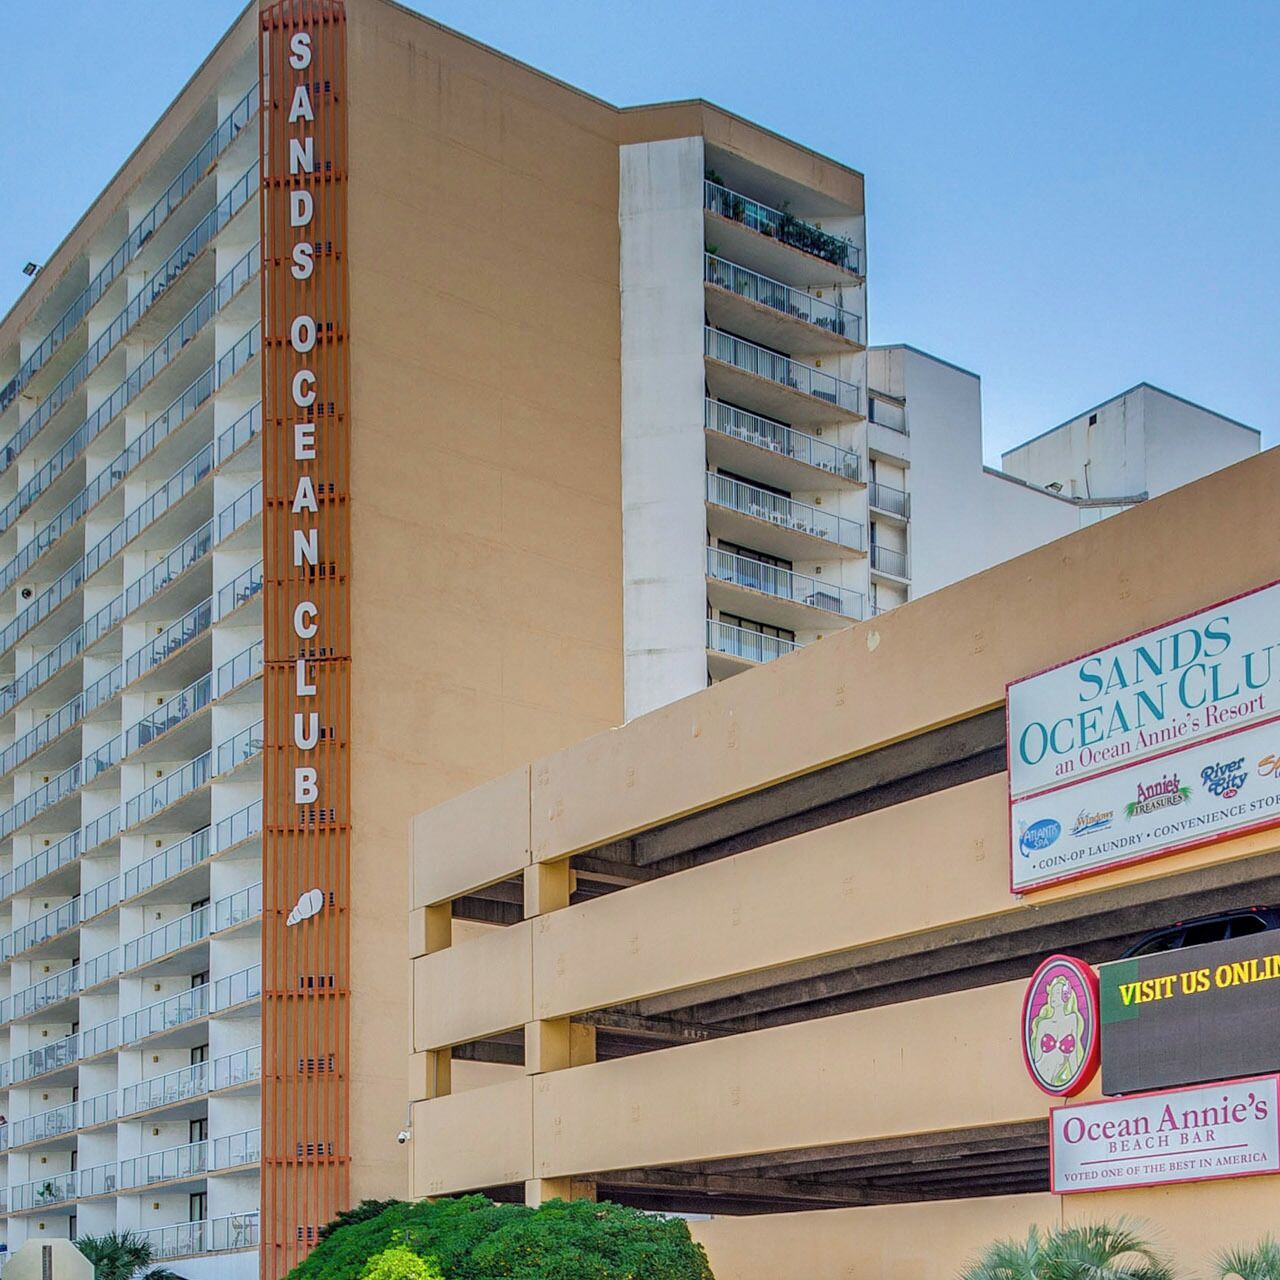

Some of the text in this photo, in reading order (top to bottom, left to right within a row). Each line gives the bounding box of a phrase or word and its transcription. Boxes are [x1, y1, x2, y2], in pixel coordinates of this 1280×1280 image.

[288, 32, 319, 805] SANDS OCEAN CLUB
[1079, 616, 1232, 702] SANDS
[1019, 682, 1168, 766] OCEAN
[1055, 693, 1265, 776] an Ocean Annie's Resort
[1136, 773, 1180, 805] Annie's
[1200, 757, 1245, 787] River
[1208, 772, 1248, 796] City
[1134, 794, 1183, 815] TREASURES
[1034, 838, 1050, 850] SPA
[1038, 848, 1086, 870] COIN-OP
[1088, 833, 1144, 857] LAUNDRY
[1153, 804, 1247, 838] CONVENIENCE
[1118, 974, 1177, 1007] VISIT
[1180, 968, 1211, 995] US
[1063, 1093, 1269, 1144] Ocean Annie's
[1108, 1129, 1217, 1153] BEACH BAR
[1064, 1152, 1269, 1182] VOTED ONE OF THE BEST IN AMERICA
